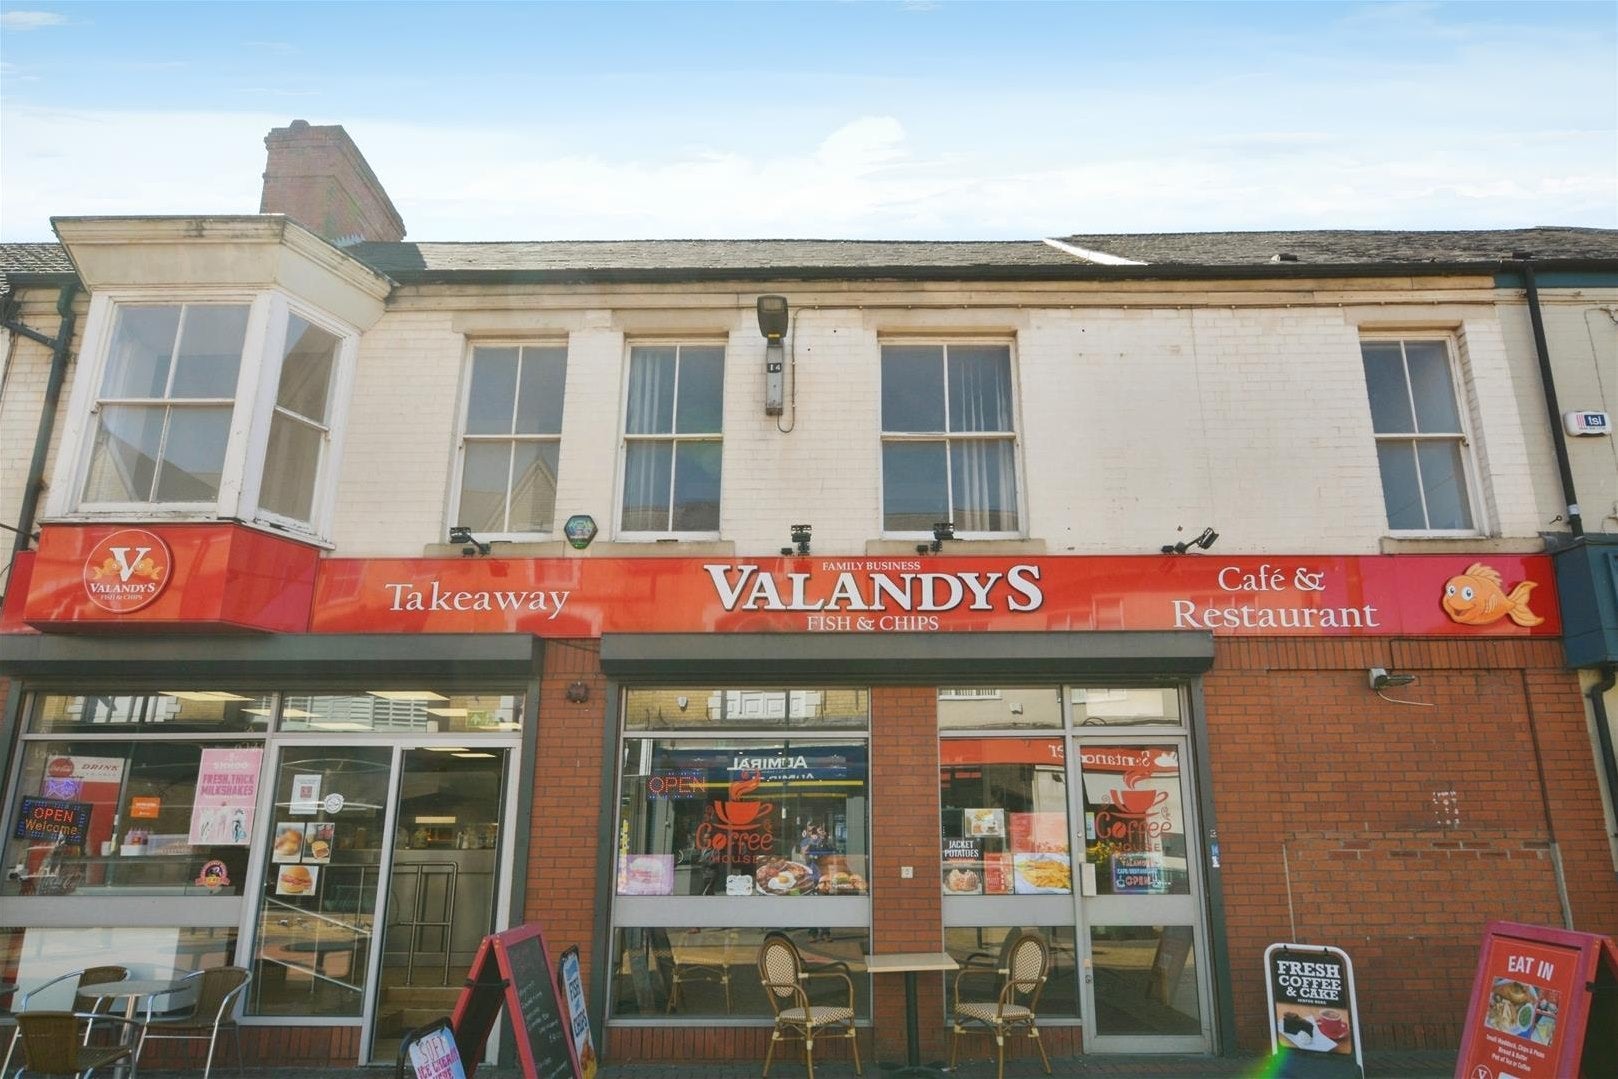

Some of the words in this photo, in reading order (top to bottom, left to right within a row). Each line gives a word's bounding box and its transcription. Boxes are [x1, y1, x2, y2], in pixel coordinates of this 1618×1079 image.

[109, 547, 151, 582] V
[822, 561, 865, 571] FAMILY
[866, 561, 921, 571] BUSINESS
[1217, 566, 1285, 592] Café
[1293, 567, 1326, 592] &
[89, 582, 156, 594] VALANDYS
[703, 564, 1044, 612] VALANDYS
[384, 581, 570, 620] Takeaway
[1173, 600, 1380, 629] Restaurant
[807, 616, 850, 631] FISH
[856, 616, 875, 631] &
[879, 616, 939, 631] CHIPS
[81, 763, 120, 771] DRINK
[200, 785, 254, 796] MILKSHAKES
[649, 776, 706, 793] OPEN
[34, 807, 74, 823] OPEN
[25, 818, 78, 835] Welcome
[1095, 811, 1172, 842] Coffee
[696, 822, 774, 855] Coffee
[949, 840, 974, 849] JACKET
[944, 849, 979, 858] POTATOES
[1125, 875, 1153, 886] OPEN
[1276, 960, 1341, 979] FRESH
[1507, 955, 1535, 974] EAT
[1537, 960, 1555, 982] IN
[1278, 974, 1342, 991] COFFEE
[1285, 986, 1298, 997] &
[1299, 987, 1340, 1001] CAKE
[419, 1035, 446, 1064] SOFT
